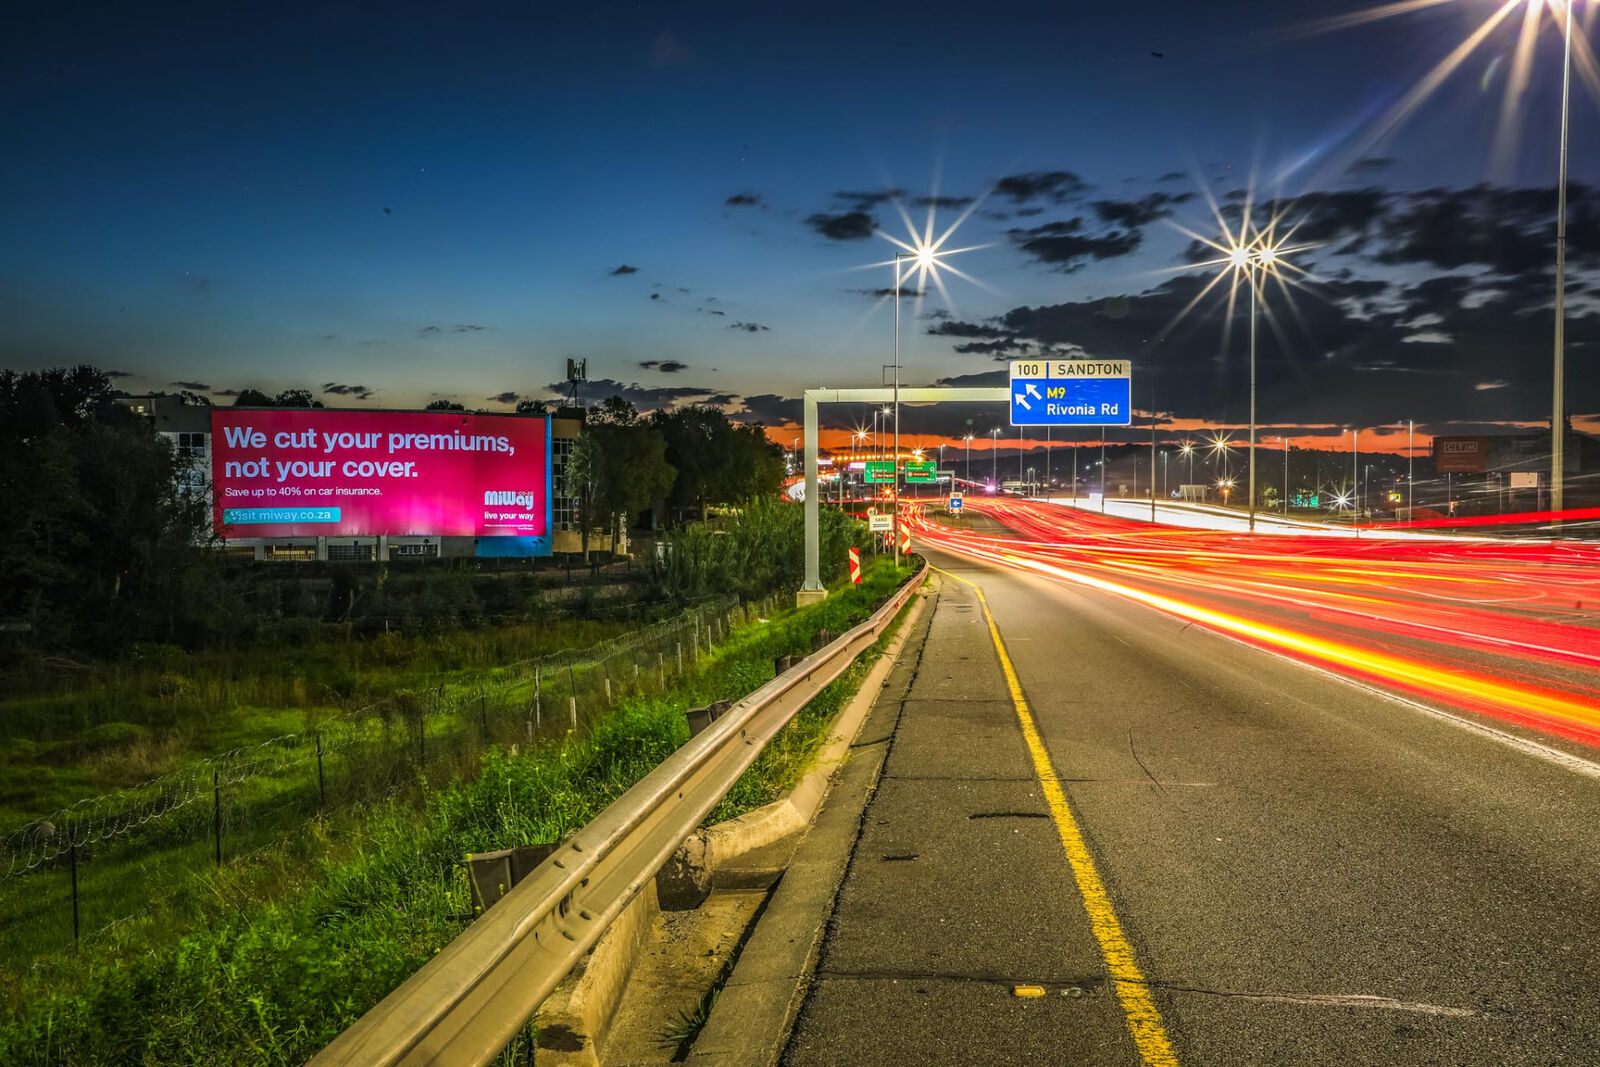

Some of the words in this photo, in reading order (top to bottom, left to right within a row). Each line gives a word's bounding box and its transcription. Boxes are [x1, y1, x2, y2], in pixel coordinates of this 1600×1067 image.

[1018, 364, 1038, 375] 100
[1058, 363, 1122, 375] SANDTON
[1046, 387, 1066, 399] M9
[1047, 403, 1096, 415] Rivonia
[1101, 403, 1118, 415] Rd
[223, 426, 267, 449] We
[274, 428, 317, 449] cut
[323, 432, 382, 453] your
[388, 429, 515, 456] premiums,
[225, 457, 270, 478] not
[276, 461, 336, 482] your
[342, 460, 418, 478] cover.
[224, 487, 249, 497] Save
[251, 488, 264, 498] up
[266, 487, 277, 496] to
[279, 486, 301, 496] 40%
[303, 488, 316, 496] on
[318, 488, 333, 496] car
[335, 486, 382, 496] insurance.
[230, 510, 256, 521] Visit
[259, 510, 331, 522] miway.co.za
[484, 511, 498, 520] live
[499, 513, 517, 521] your
[518, 513, 534, 521] way
